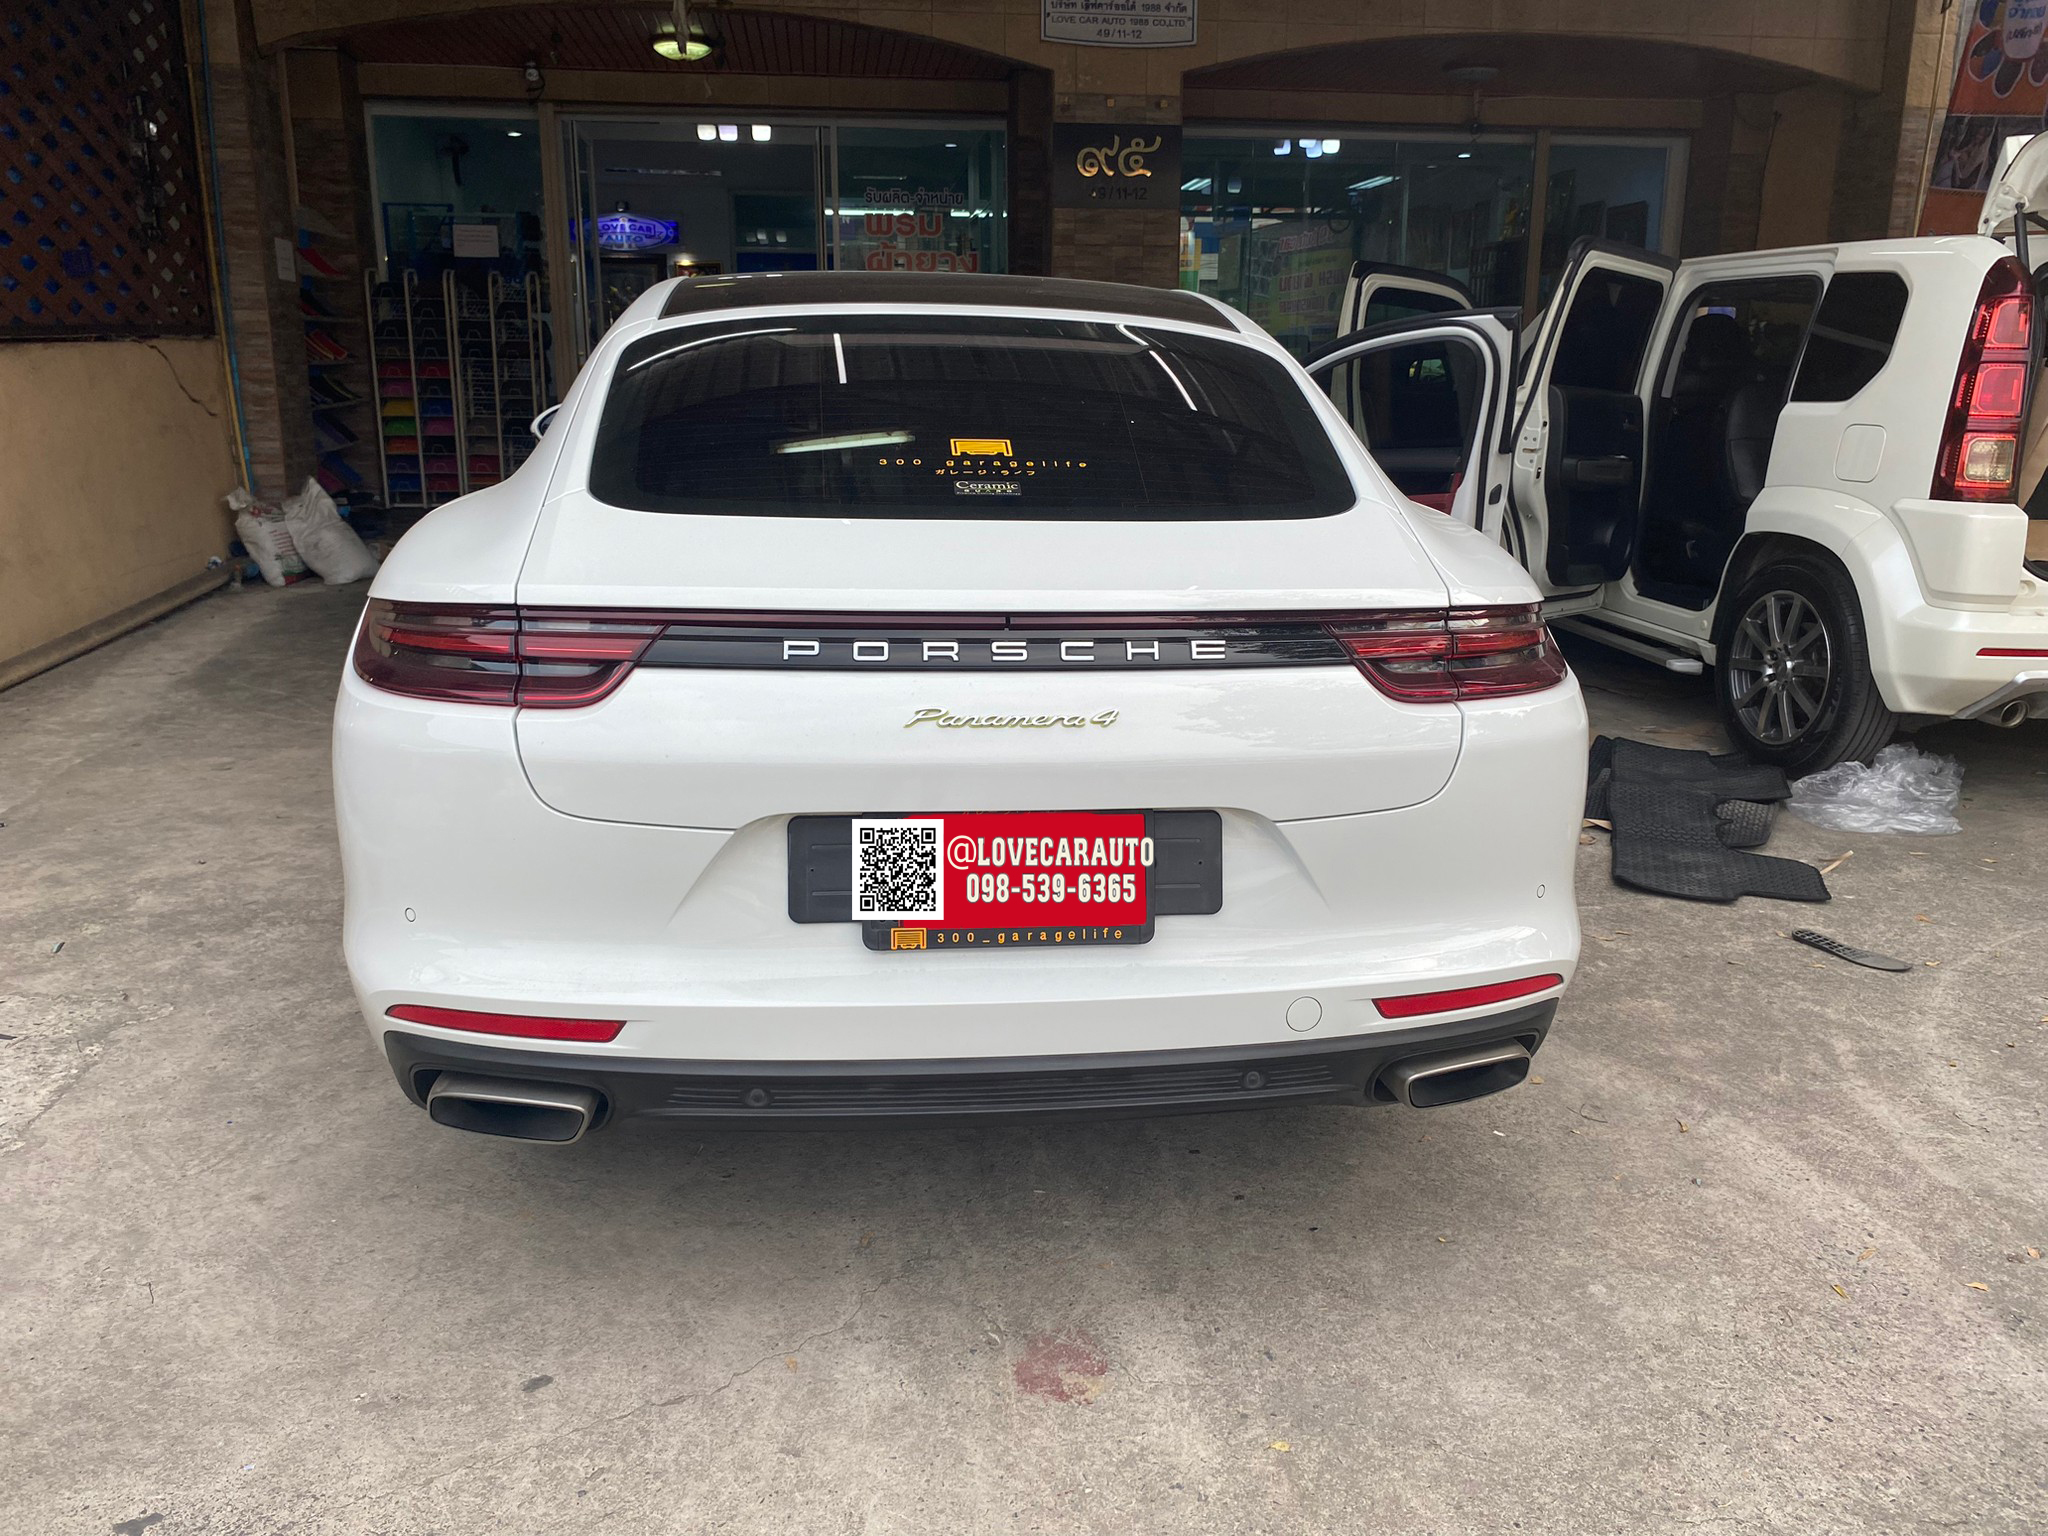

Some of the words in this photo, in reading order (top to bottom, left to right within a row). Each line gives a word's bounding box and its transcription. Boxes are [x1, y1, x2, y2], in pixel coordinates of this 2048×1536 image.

[1051, 15, 1076, 24] LOVE
[1079, 16, 1099, 25] CAR
[1101, 17, 1127, 26] AUTO
[1096, 29, 1142, 39] 49/11-12
[865, 213, 944, 237] พรม
[879, 458, 922, 466] 300
[955, 480, 1019, 490] Ceramic
[783, 640, 1226, 662] PORSCHE
[903, 704, 1086, 729] Panamera
[1088, 707, 1120, 728] 4
[937, 928, 1123, 944] 300_garagelife
